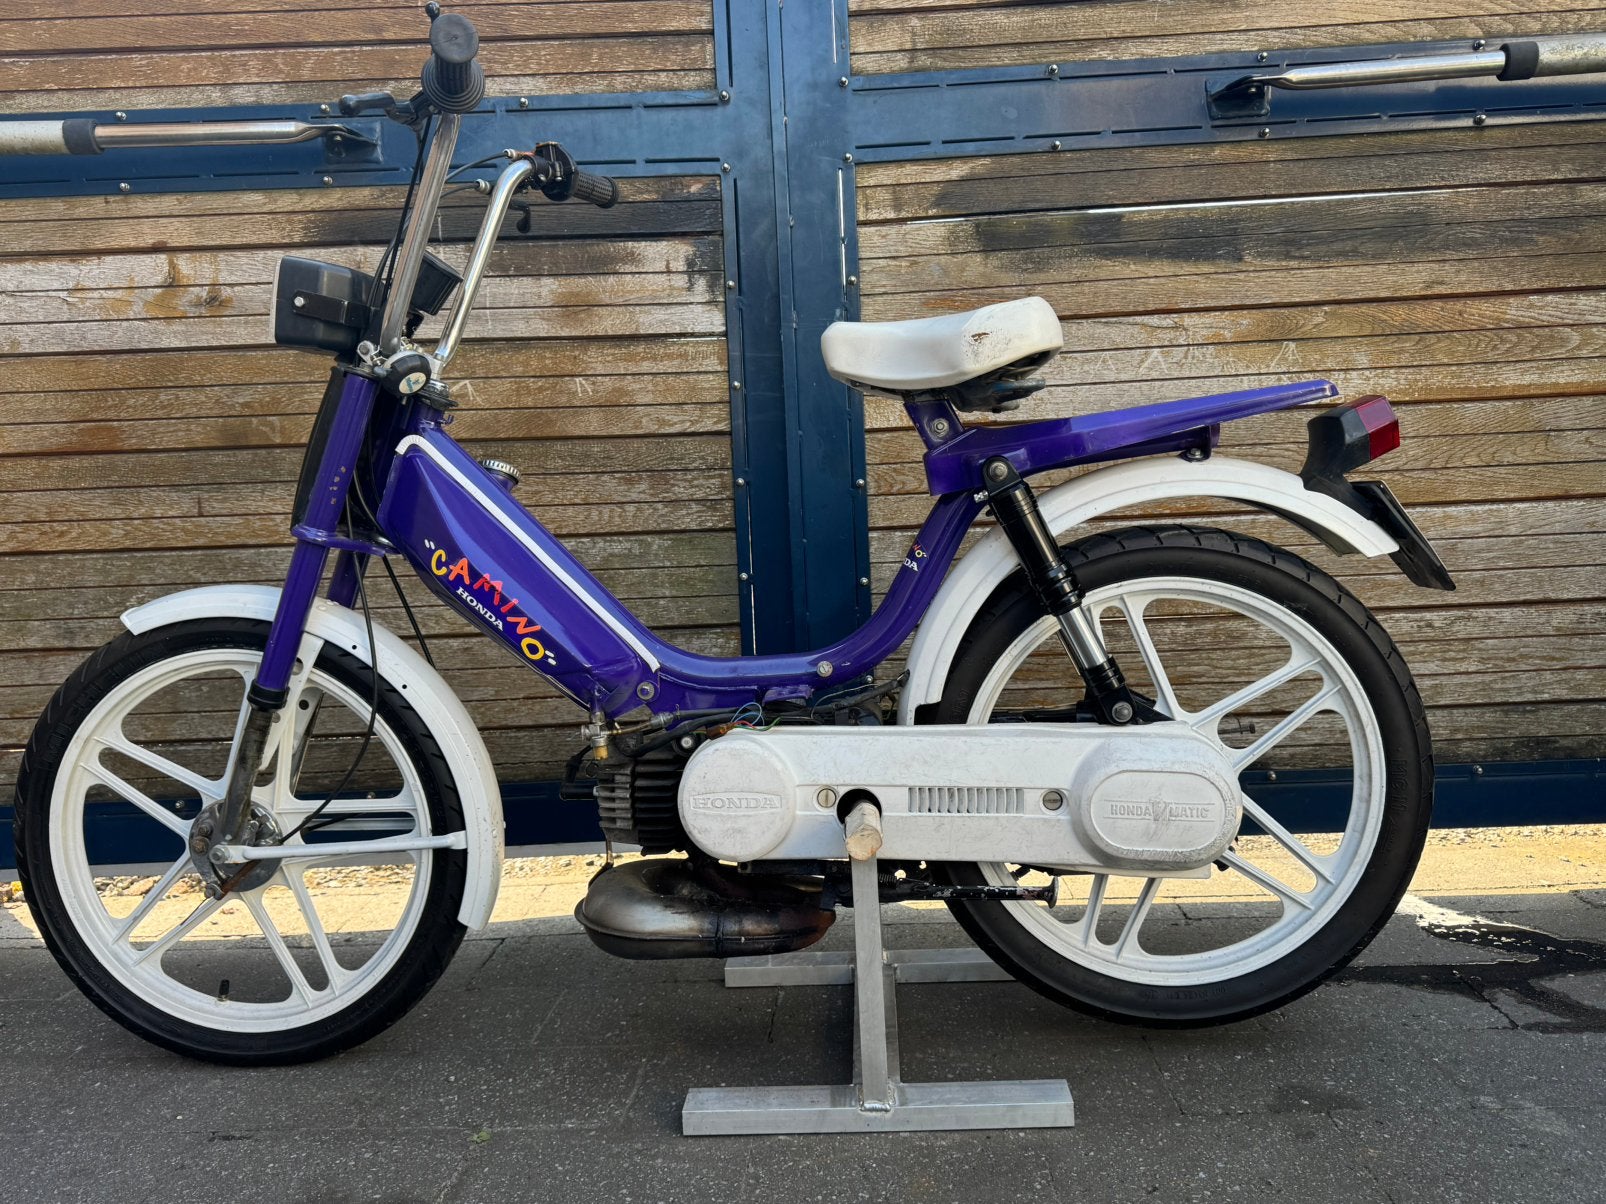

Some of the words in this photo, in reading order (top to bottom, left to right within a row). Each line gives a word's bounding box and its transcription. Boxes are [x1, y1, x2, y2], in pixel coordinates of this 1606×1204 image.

[456, 586, 504, 632] HONDA
[692, 797, 780, 809] HONDA
[1110, 803, 1153, 817] HONDA
[1168, 805, 1211, 818] MATIC
